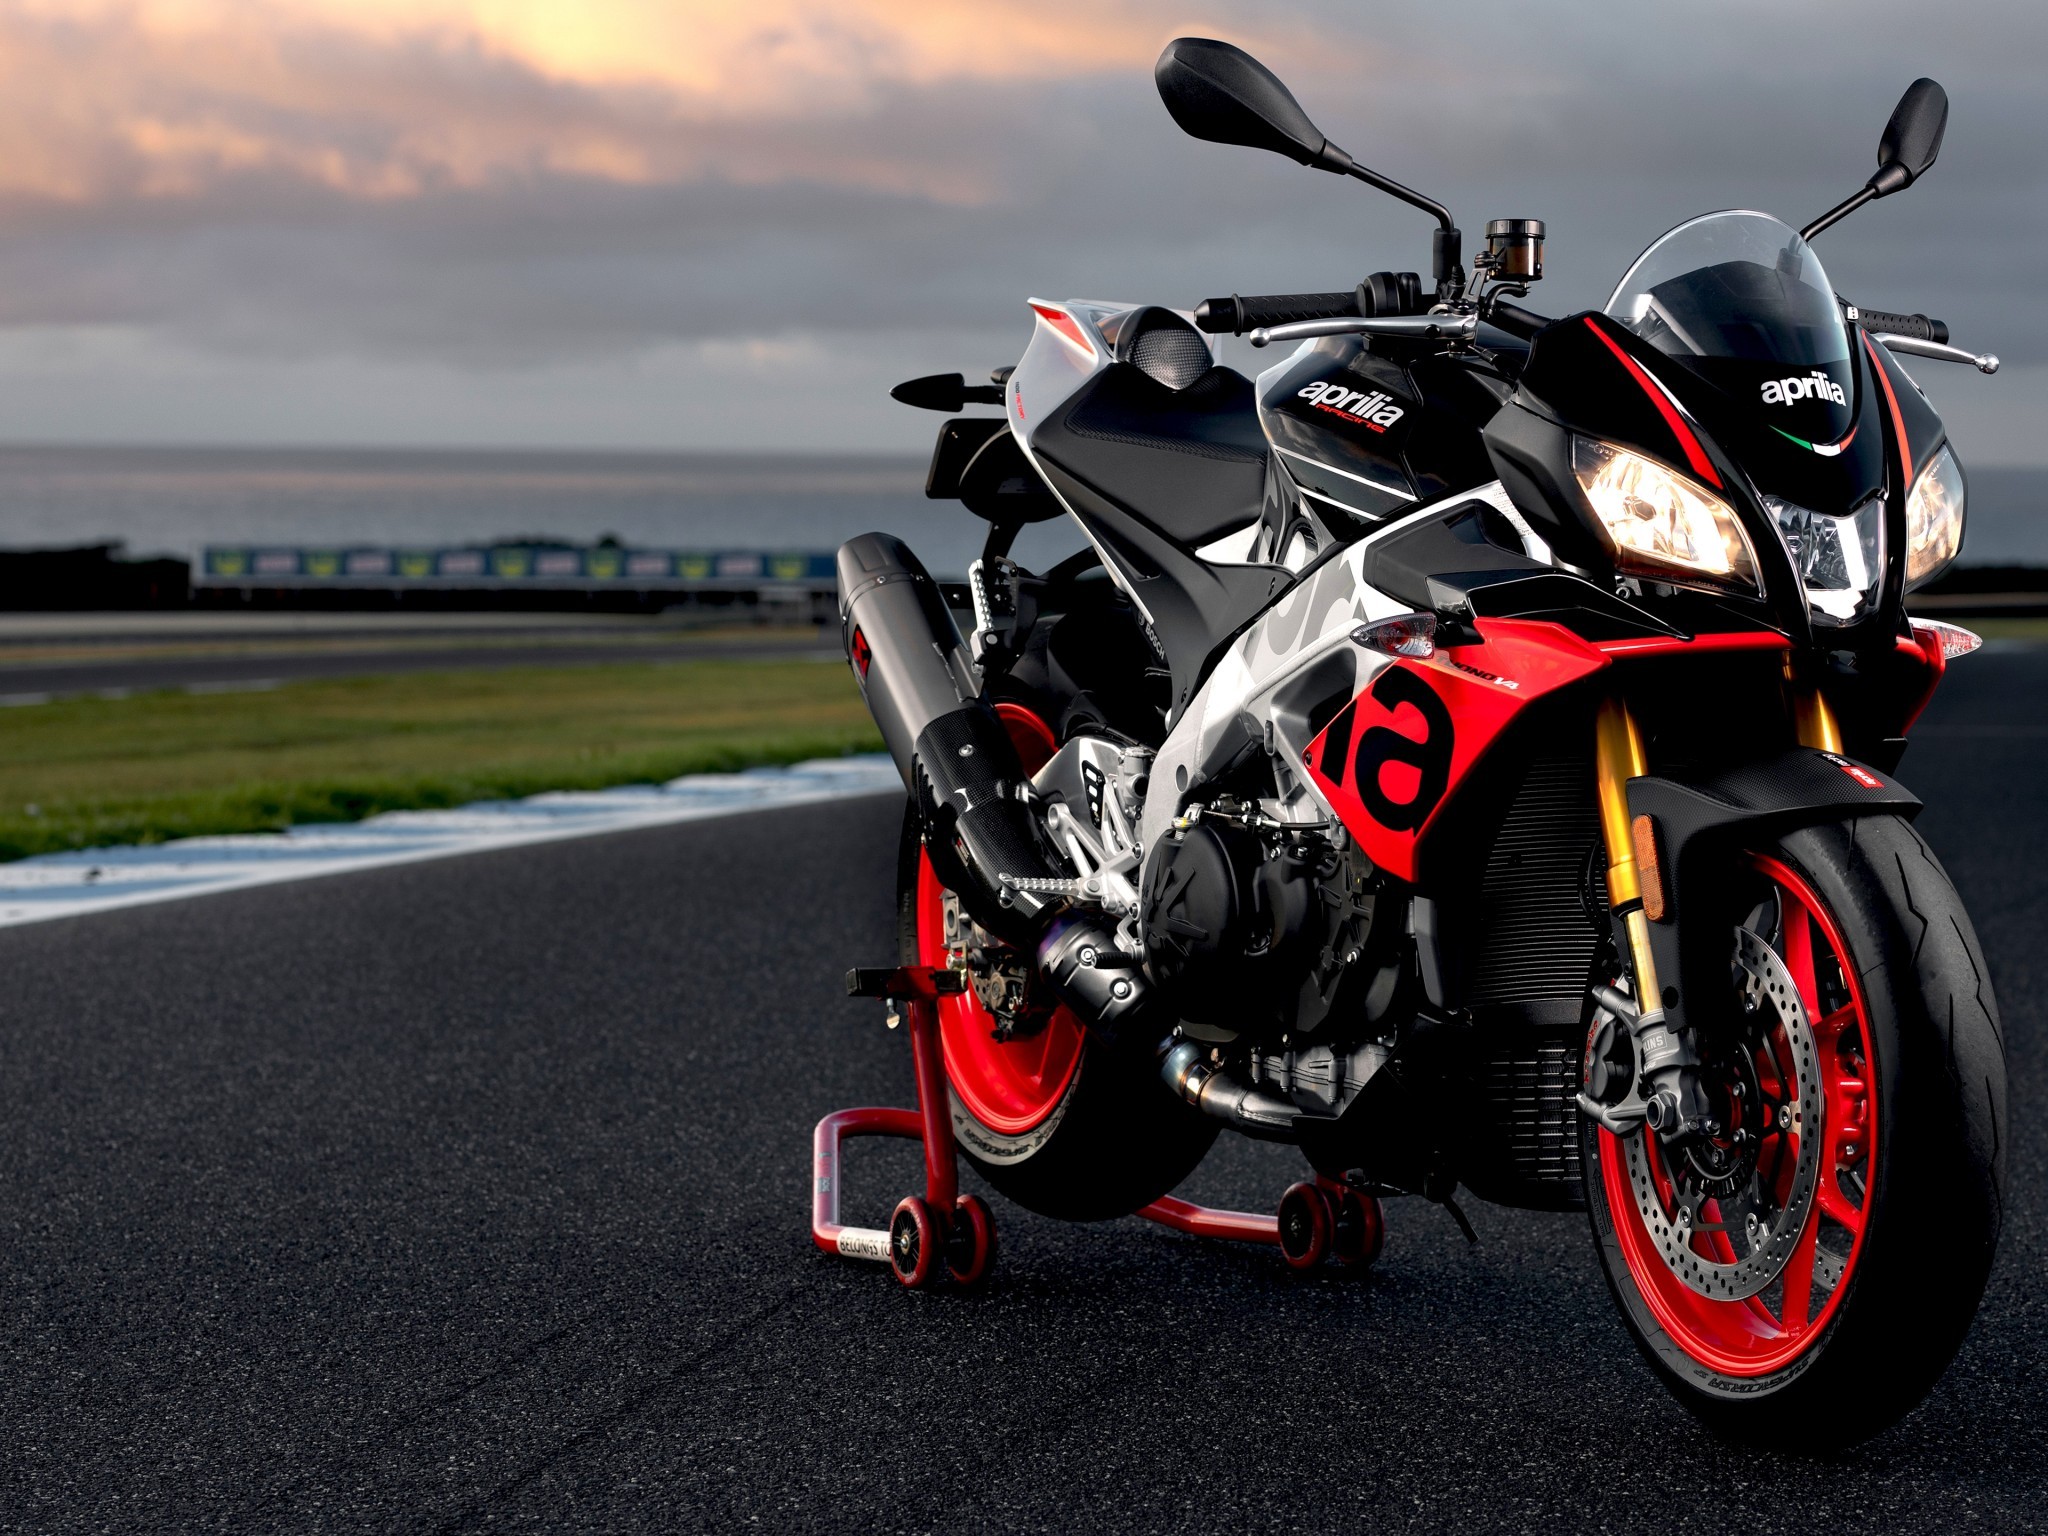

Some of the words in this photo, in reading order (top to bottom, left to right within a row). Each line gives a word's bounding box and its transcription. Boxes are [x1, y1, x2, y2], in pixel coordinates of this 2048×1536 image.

[1297, 380, 1405, 428] aprilia
[1760, 370, 1847, 406] aprilia
[1145, 622, 1165, 660] BOSCH
[1584, 1019, 1599, 1084] brembo
[1642, 1035, 1664, 1051] LINS
[840, 1236, 878, 1256] BELONGS
